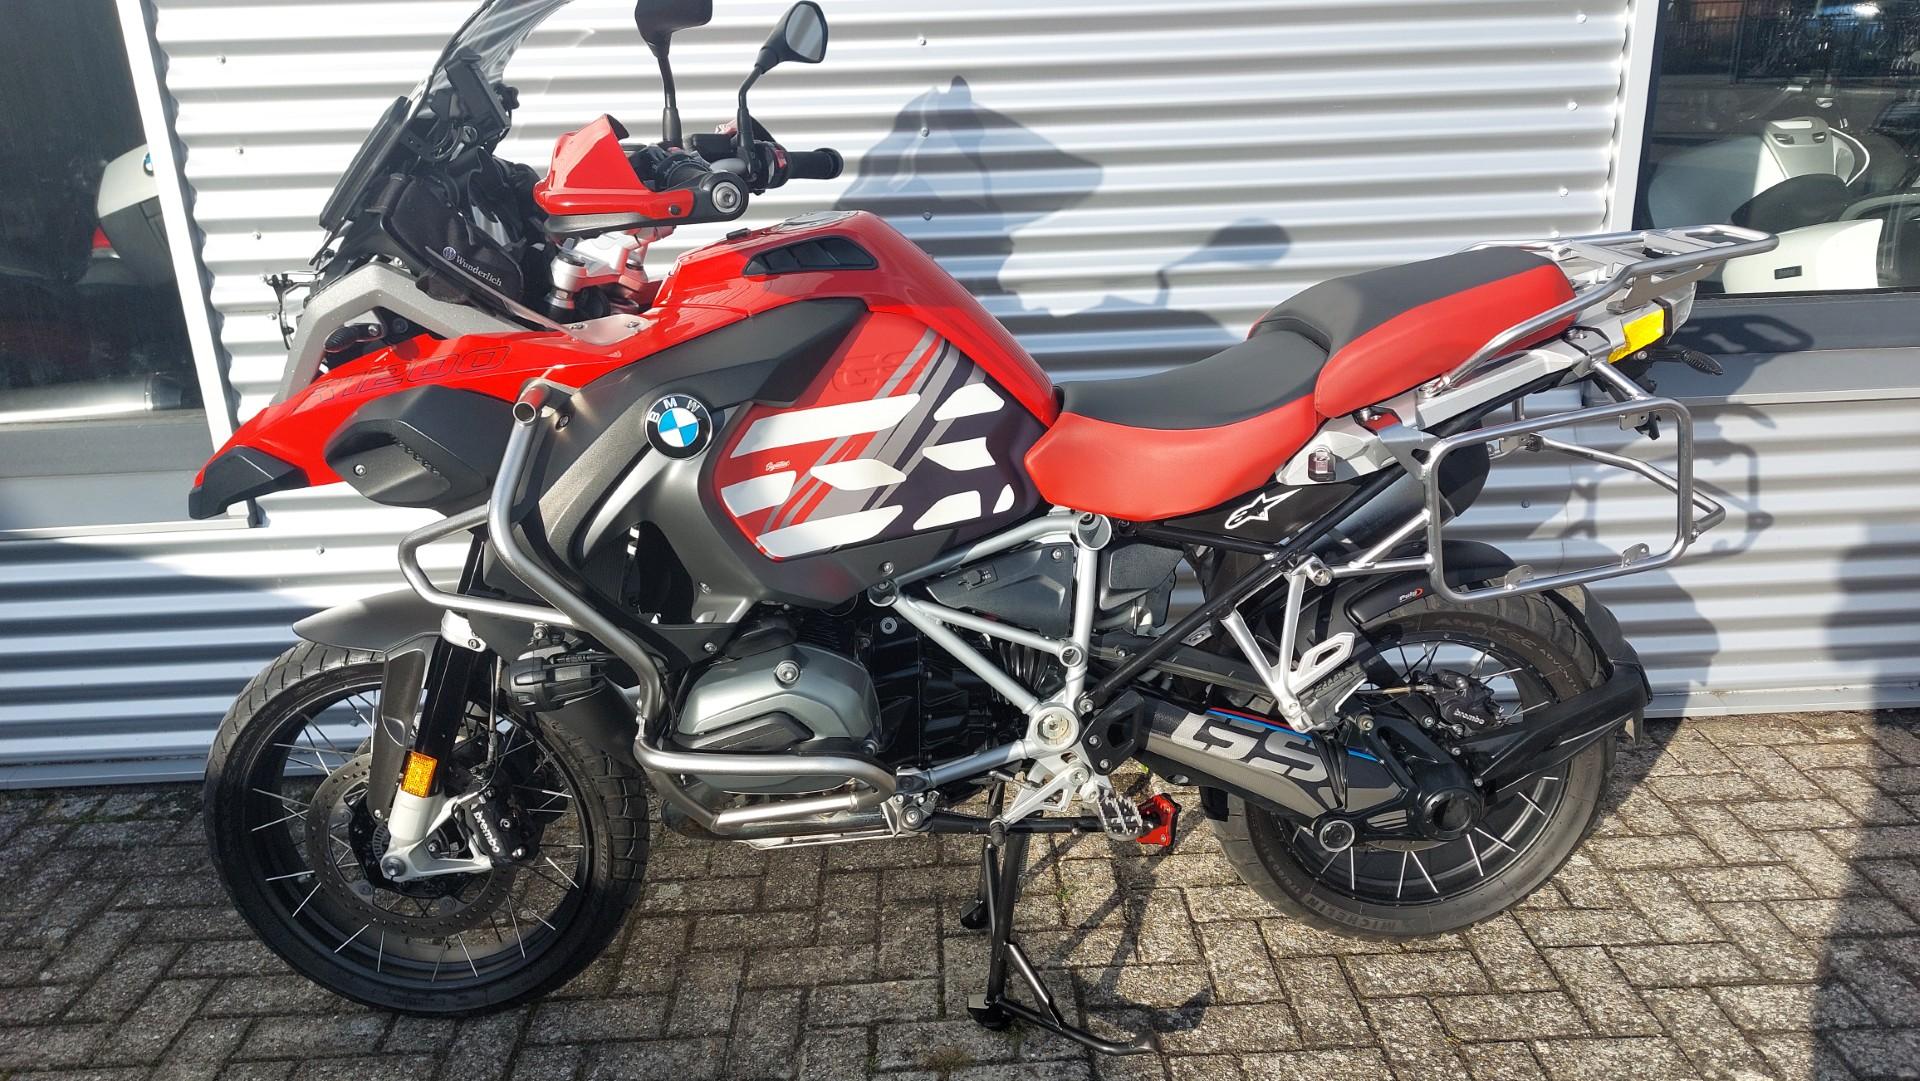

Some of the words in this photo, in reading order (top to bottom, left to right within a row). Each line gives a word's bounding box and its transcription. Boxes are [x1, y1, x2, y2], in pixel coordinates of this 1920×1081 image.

[456, 255, 502, 287] Wunderlich
[648, 397, 701, 423] BMW
[1454, 708, 1485, 725] brembo
[1171, 711, 1328, 783] GS
[473, 810, 500, 853] brembo
